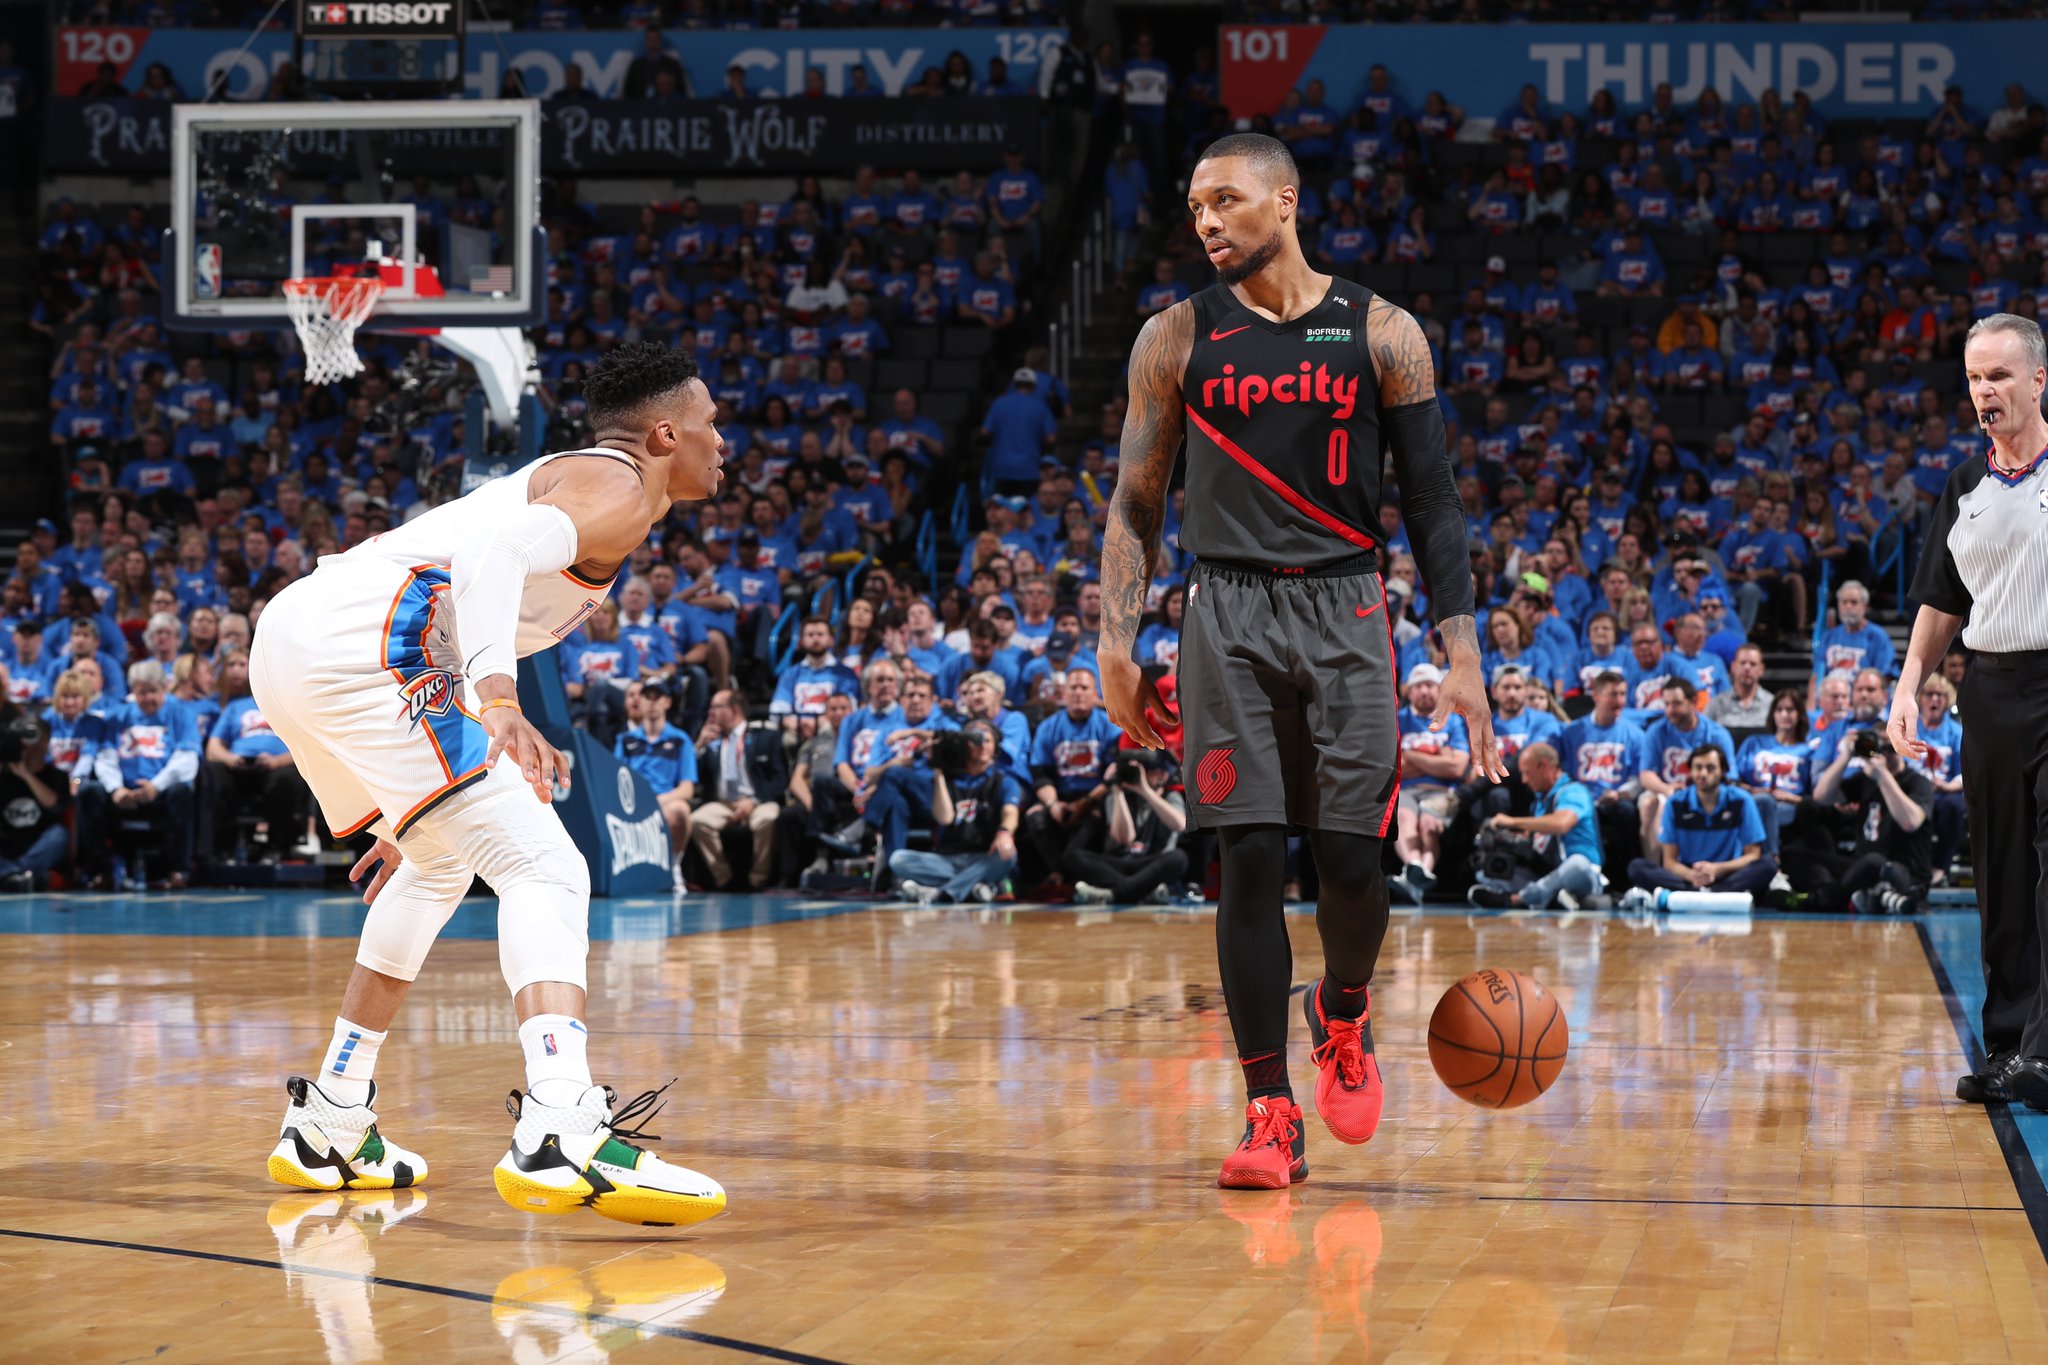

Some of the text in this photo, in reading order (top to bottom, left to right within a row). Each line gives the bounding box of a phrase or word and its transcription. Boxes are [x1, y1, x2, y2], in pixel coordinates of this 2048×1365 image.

[347, 2, 451, 25] TISSOT
[62, 31, 134, 63] 120
[1226, 30, 1289, 62] 101
[724, 47, 925, 98] CITY
[1529, 42, 1957, 104] THUNDER
[556, 103, 1008, 170] PRAIRIE WOLF DISTILLERY
[1202, 360, 1359, 420] ripcity
[1327, 428, 1349, 486] 0
[409, 675, 444, 722] OKC
